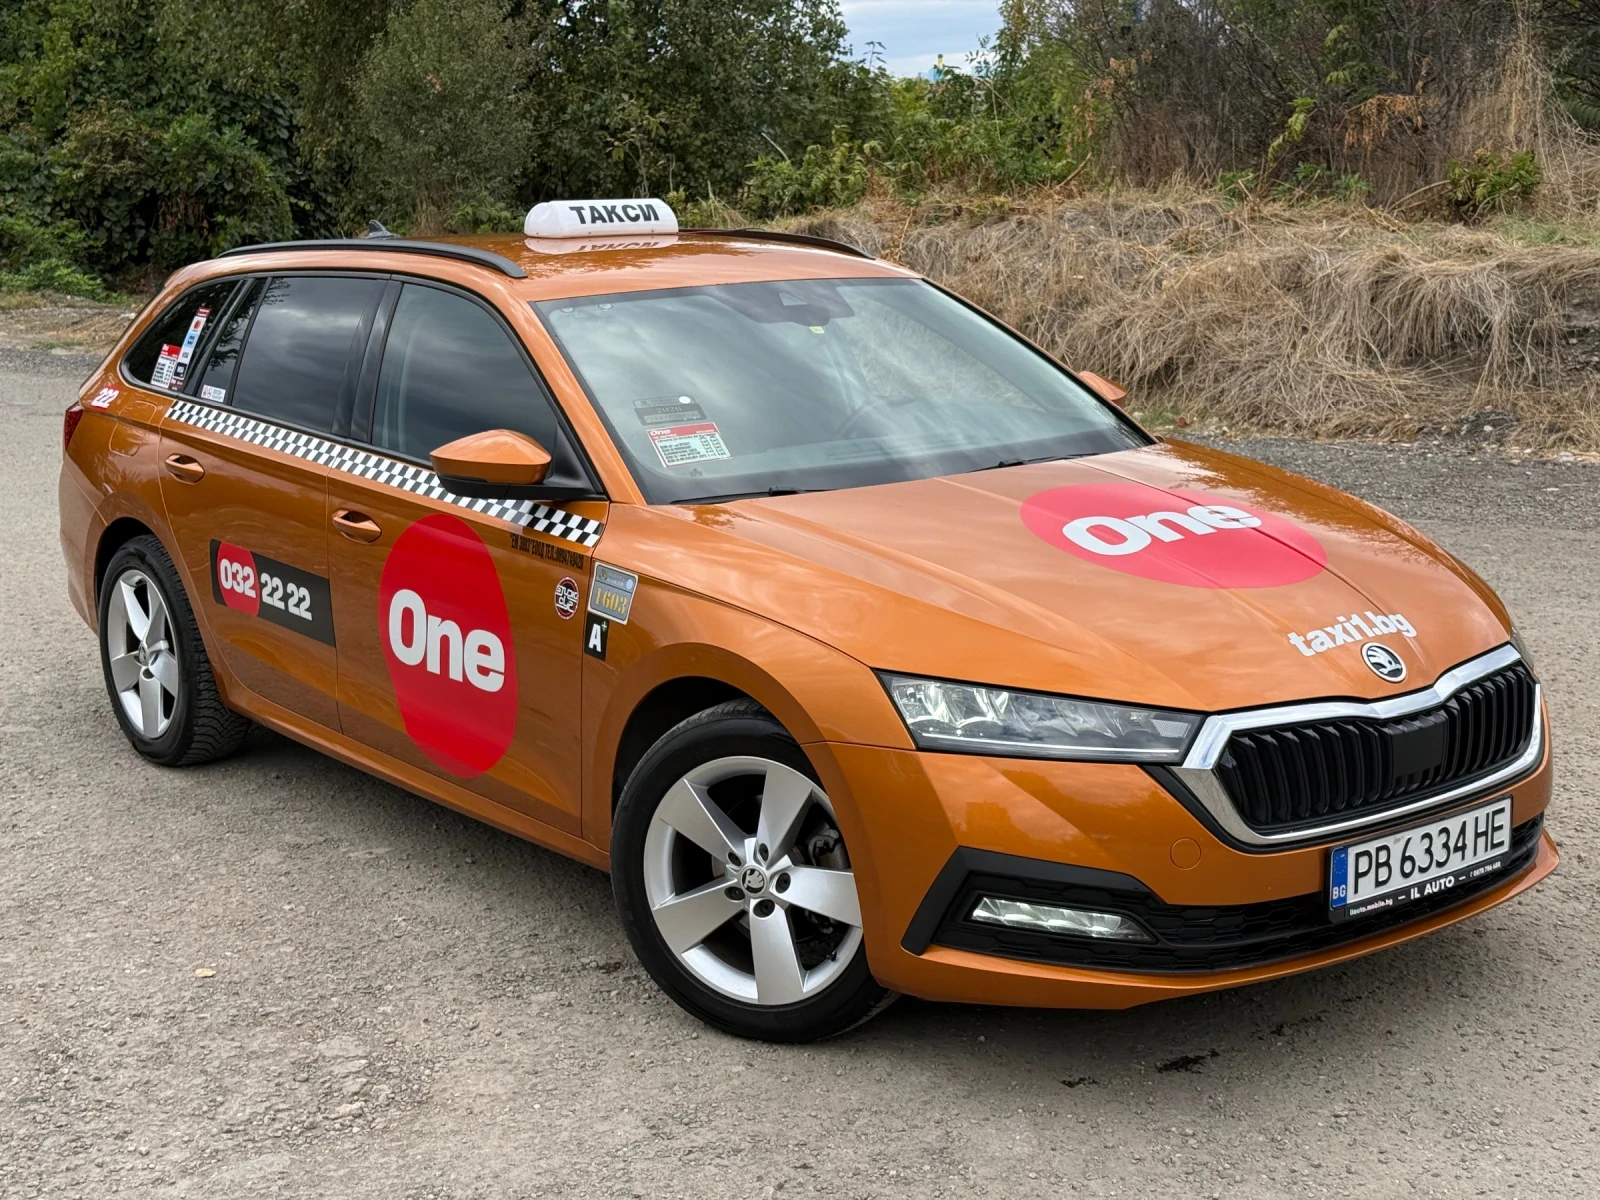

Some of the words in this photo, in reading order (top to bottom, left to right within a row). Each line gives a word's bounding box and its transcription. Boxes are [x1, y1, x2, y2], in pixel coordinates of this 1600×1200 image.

[569, 203, 660, 225] ТАКСИ
[91, 387, 120, 409] 222
[650, 428, 671, 436] One
[1062, 505, 1263, 556] One
[219, 558, 257, 598] 032
[260, 572, 285, 611] 22
[287, 582, 313, 621] 22
[594, 587, 628, 615] 1603
[388, 588, 505, 693] One
[1287, 610, 1418, 657] taxi1.bg
[1353, 843, 1393, 895] PB
[1400, 820, 1468, 879] 6334
[1473, 806, 1506, 858] HE
[1332, 884, 1347, 900] BG
[1410, 886, 1420, 900] IL
[1424, 875, 1455, 896] AUTO
